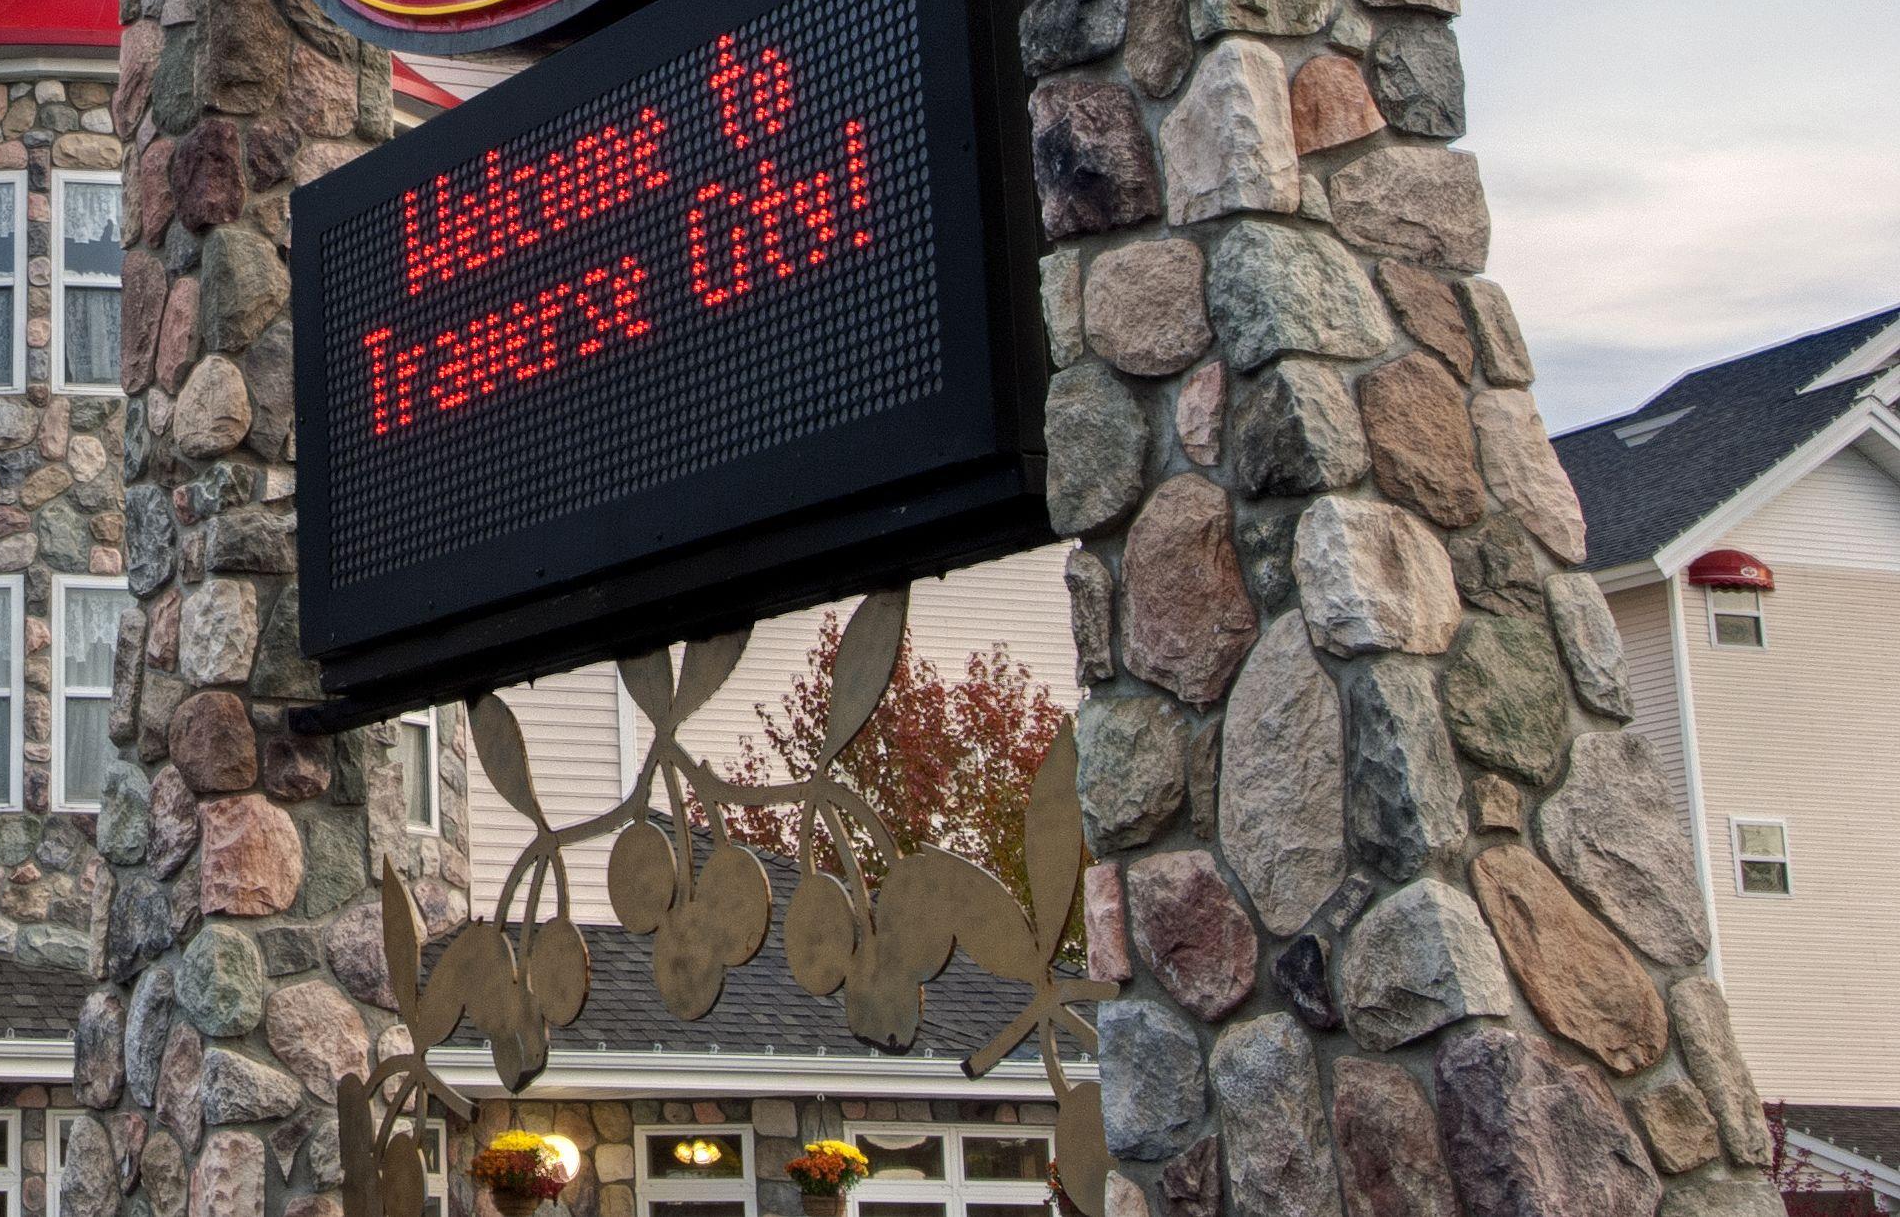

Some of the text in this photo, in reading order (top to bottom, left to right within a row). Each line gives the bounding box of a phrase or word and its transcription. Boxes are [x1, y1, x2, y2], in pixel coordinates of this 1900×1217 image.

[363, 119, 874, 435] Traverse City!
[403, 33, 796, 297] Welcome to
